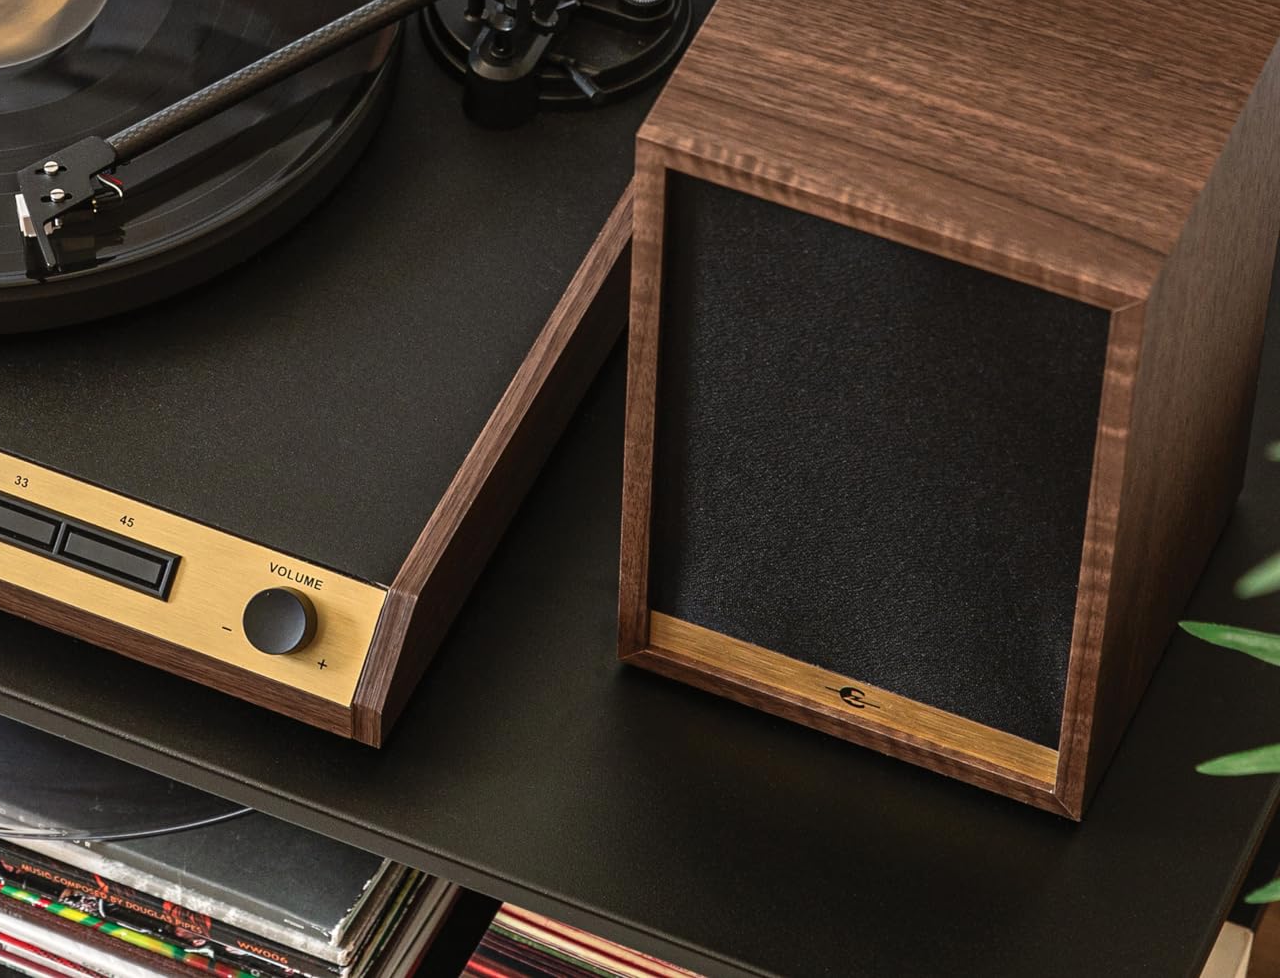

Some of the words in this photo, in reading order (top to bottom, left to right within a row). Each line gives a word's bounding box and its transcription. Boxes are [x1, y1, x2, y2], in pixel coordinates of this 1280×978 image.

[14, 475, 29, 488] 33
[120, 515, 135, 528] 45
[270, 562, 323, 590] VOLUME
[21, 863, 52, 881] MUSIC
[53, 877, 108, 900] COMPOSED
[110, 895, 122, 906] BY
[125, 901, 172, 924] DOUGLAS
[175, 920, 203, 935] PIPES
[237, 939, 289, 964] WW006
